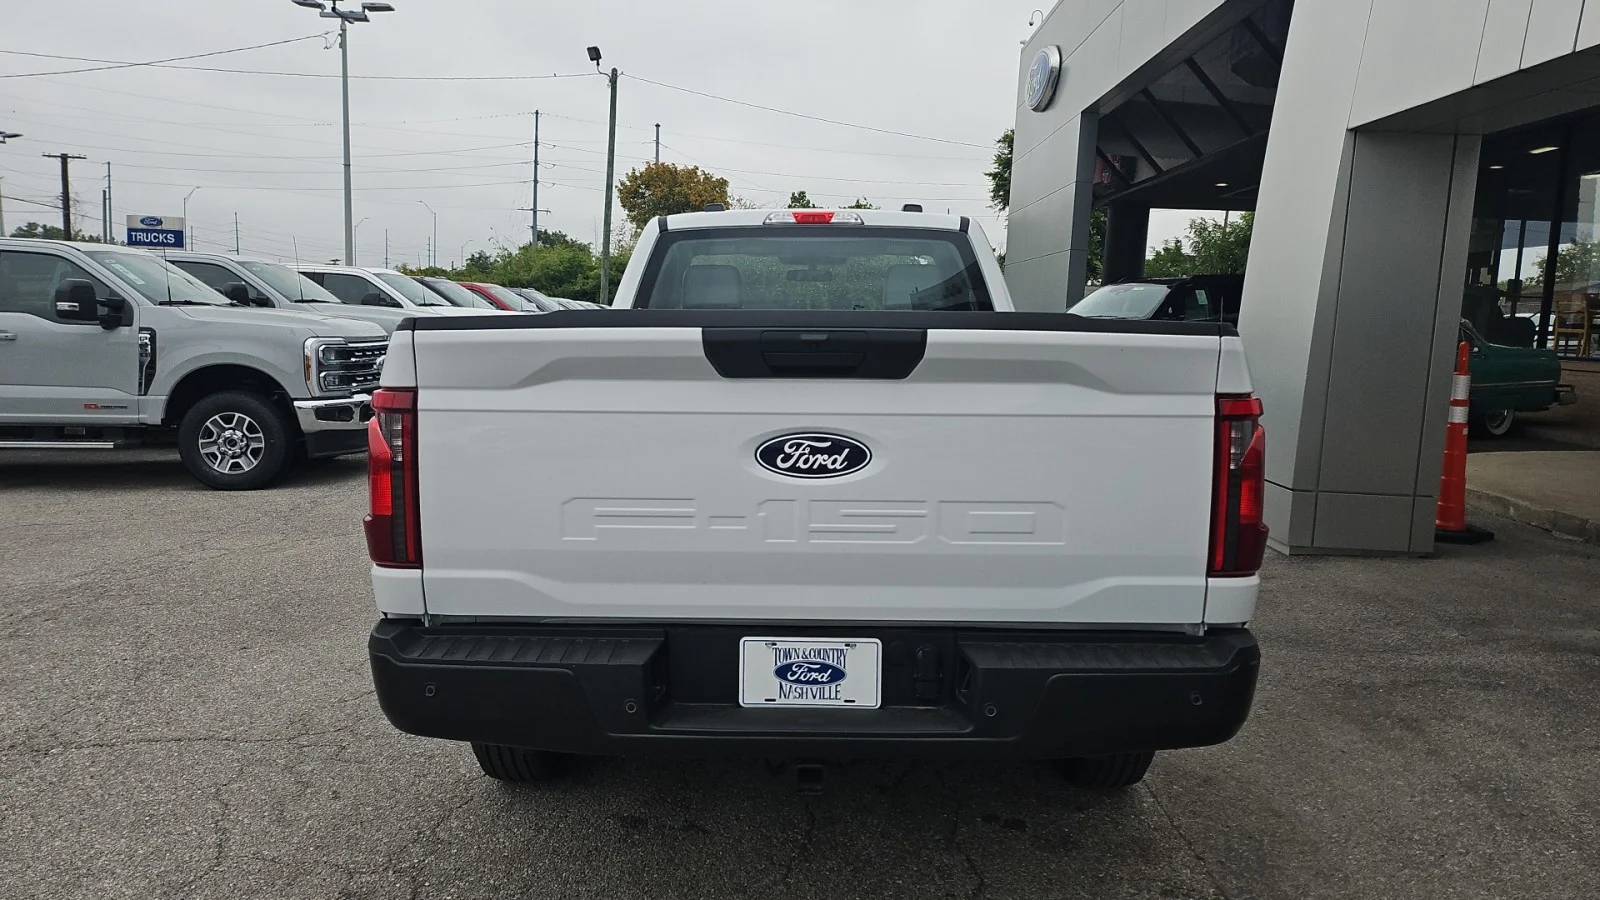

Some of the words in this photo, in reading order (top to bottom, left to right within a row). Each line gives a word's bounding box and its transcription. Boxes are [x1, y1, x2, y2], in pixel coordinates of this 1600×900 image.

[131, 232, 175, 244] TRUCKS
[776, 440, 850, 470] Ford
[561, 498, 1067, 545] F-150
[772, 647, 800, 666] TOWN
[808, 648, 848, 669] COUNTRY
[787, 662, 832, 682] Ford
[779, 681, 841, 700] NASHVILLE
